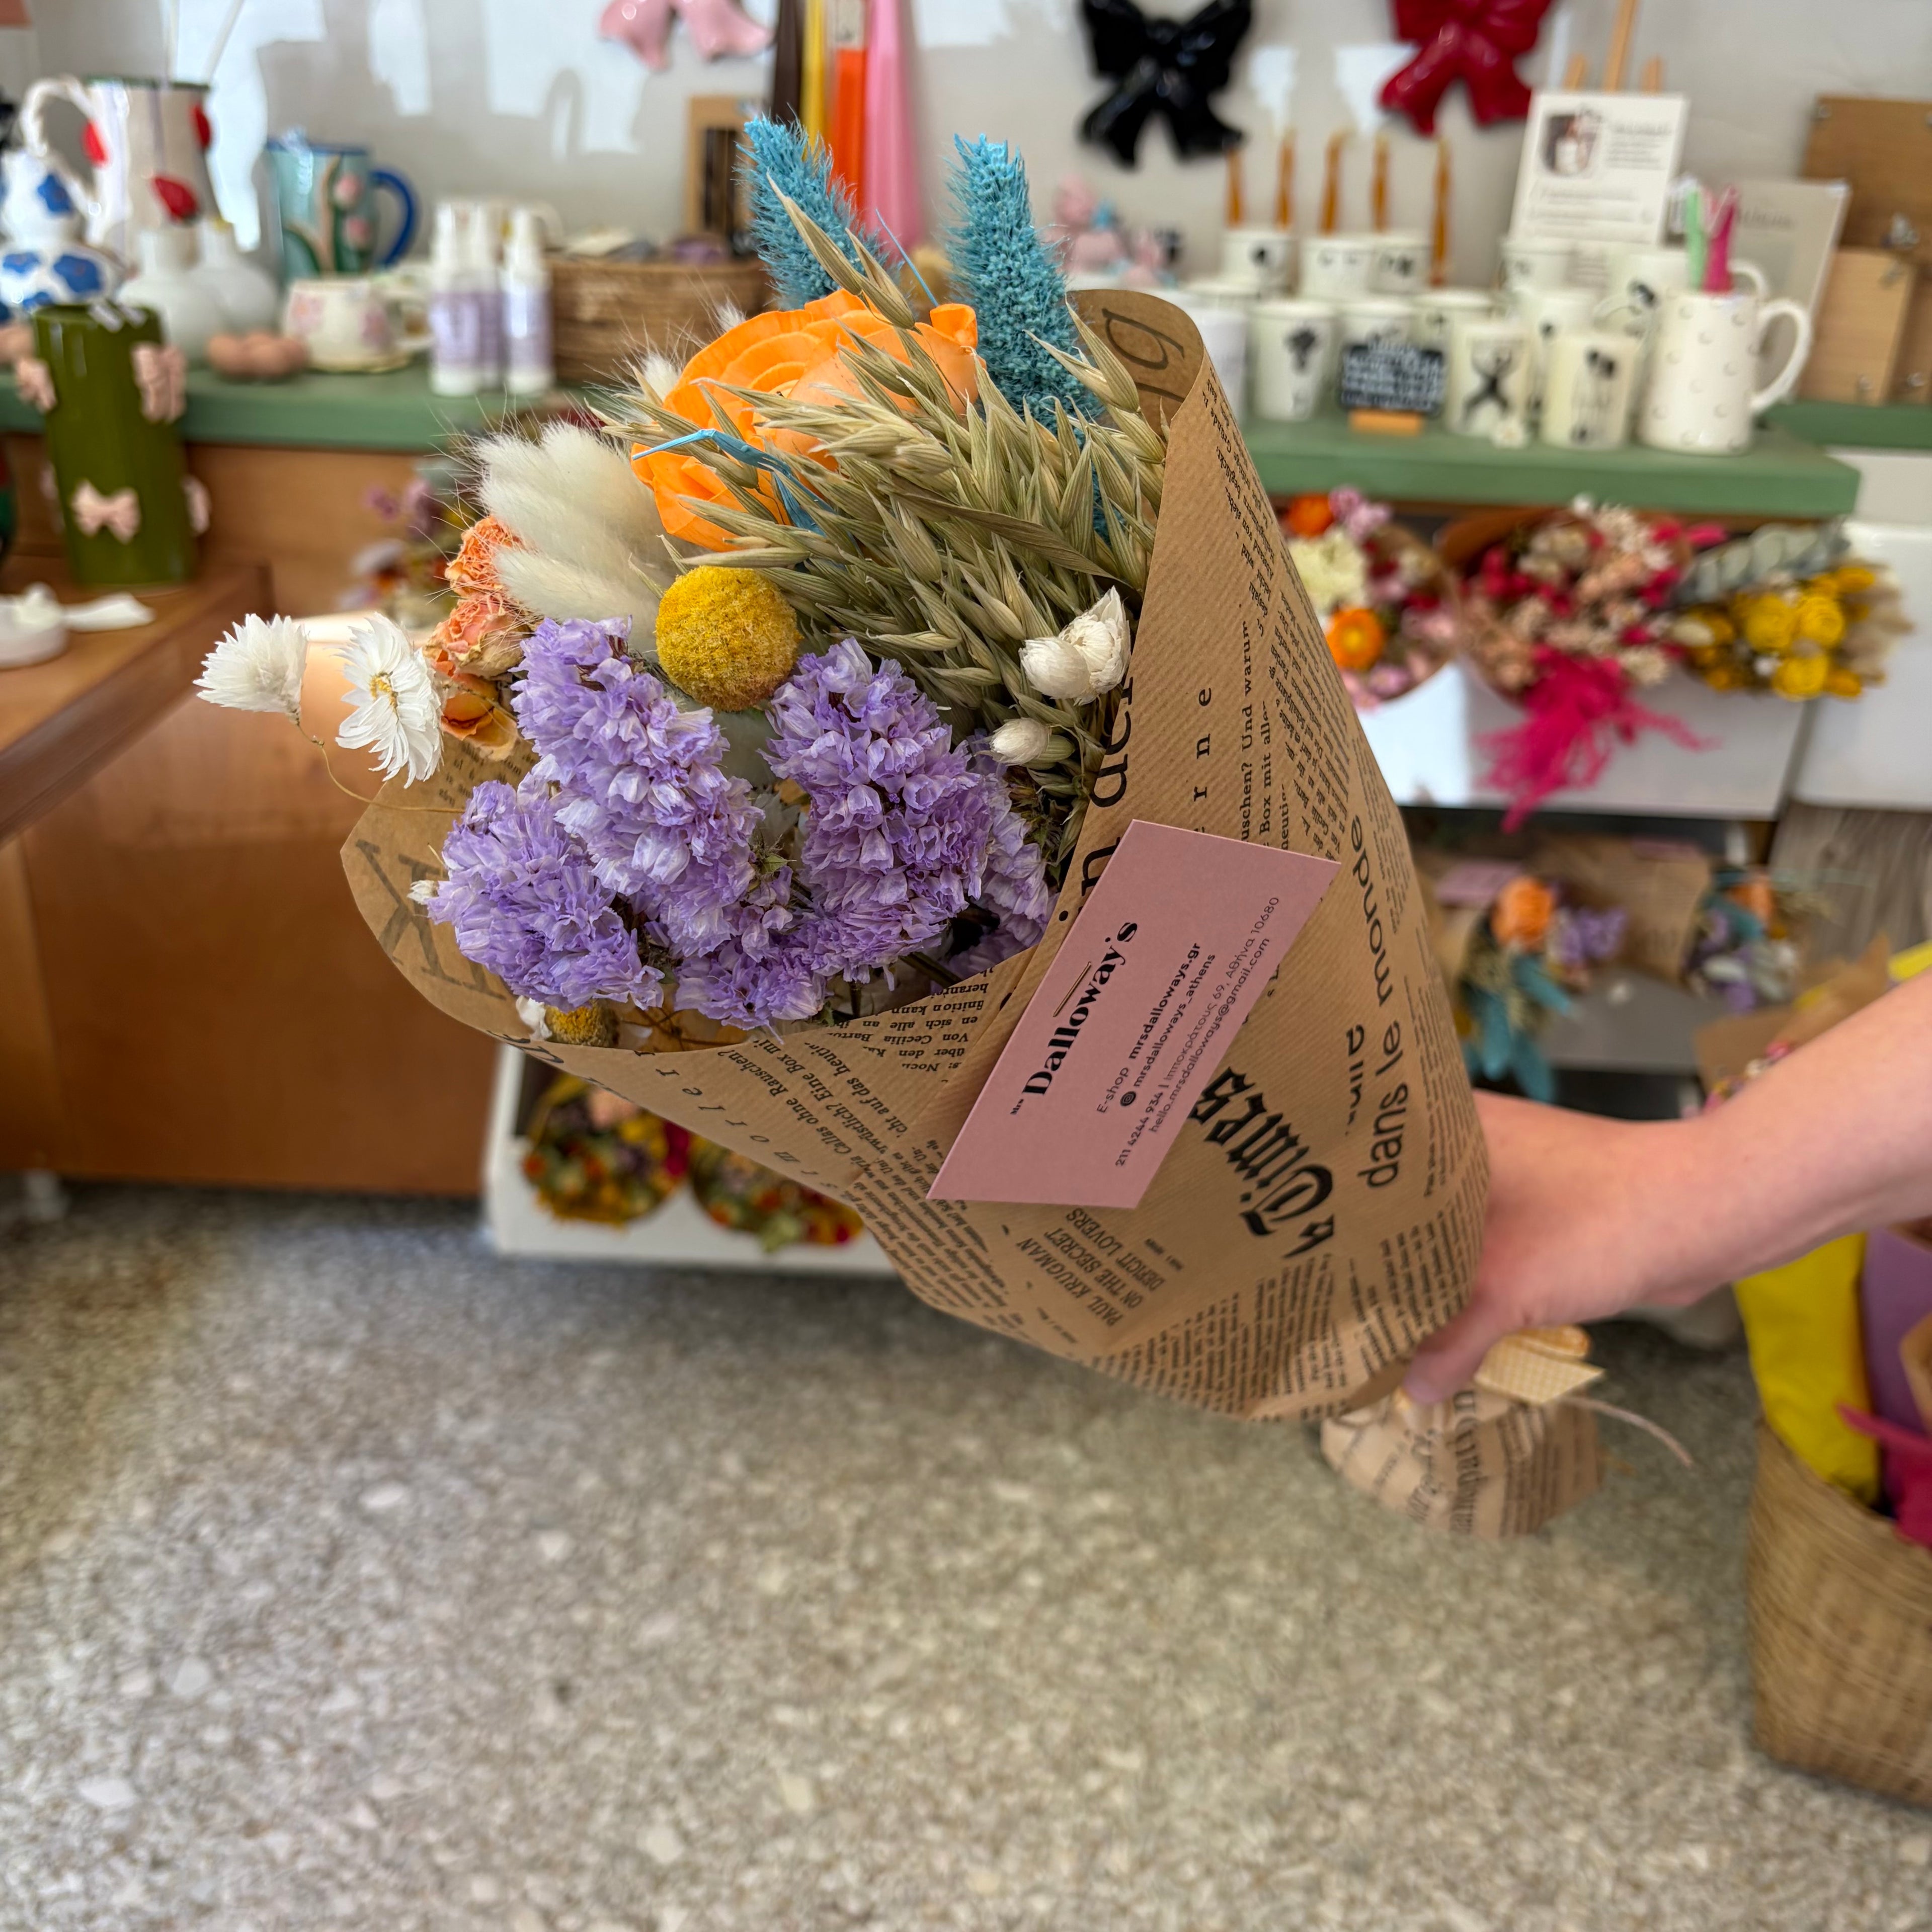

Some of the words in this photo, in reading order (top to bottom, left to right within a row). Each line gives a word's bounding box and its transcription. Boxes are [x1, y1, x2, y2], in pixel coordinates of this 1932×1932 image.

[1211, 407, 1232, 453] Gründe
[1242, 518, 1252, 541] von
[1241, 543, 1254, 570] wird
[1253, 538, 1274, 581] Abstand
[1241, 704, 1253, 752] Und
[1279, 709, 1295, 734] keine
[1314, 739, 1323, 760] Die
[1261, 752, 1271, 789] mit
[1296, 760, 1306, 778] ihr
[1308, 775, 1315, 789] an
[1239, 762, 1252, 841] uschen?
[1316, 788, 1326, 806] alle
[1259, 795, 1271, 835] Box
[1311, 805, 1329, 836] Cecilia
[1331, 832, 1340, 854] Von
[1351, 815, 1390, 1007] monde
[890, 1020, 915, 1031] alle
[925, 1019, 952, 1030] sich
[961, 1016, 978, 1024] en
[1010, 1098, 1024, 1115] Mrs
[1021, 922, 1138, 1095] Dalloway's
[1096, 1067, 1129, 1113] E-shop
[1129, 943, 1200, 1059] mrsdalloways.gr
[1115, 1149, 1131, 1166] 211
[1127, 1116, 1149, 1146] 4244
[1145, 1092, 1164, 1113] 934
[1225, 938, 1255, 979] Αθήνα
[1250, 897, 1279, 934] 10680
[1133, 954, 1216, 1087] mrsdalloways_athens
[883, 1035, 933, 1045] Cecilia
[942, 1032, 969, 1042] Von
[1148, 938, 1270, 1133] hello.mrsdalloways@gmail.com
[1375, 1020, 1403, 1077] le
[777, 1054, 806, 1074] Box
[899, 1050, 925, 1059] den
[934, 1048, 965, 1058] über
[717, 1050, 789, 1095] Rauschen?
[846, 1077, 870, 1096] das
[802, 1073, 834, 1102] Eine
[786, 1098, 819, 1124] ohne
[860, 1096, 890, 1115] auf
[816, 1126, 852, 1154] Callas
[885, 1115, 908, 1138] cht
[1357, 1083, 1408, 1188] dans
[1187, 1066, 1333, 1238] Times
[900, 1161, 923, 1175] gibt
[900, 1187, 921, 1201] und
[1065, 1208, 1123, 1256] LOVERS
[1043, 1228, 1102, 1273] SECRET
[1016, 1237, 1092, 1299] KRUGMAN
[1094, 1268, 1126, 1296] THE
[1115, 1252, 1166, 1292] DEFICIT
[1087, 1296, 1123, 1327] PAUL
[1119, 1290, 1144, 1309] ON
